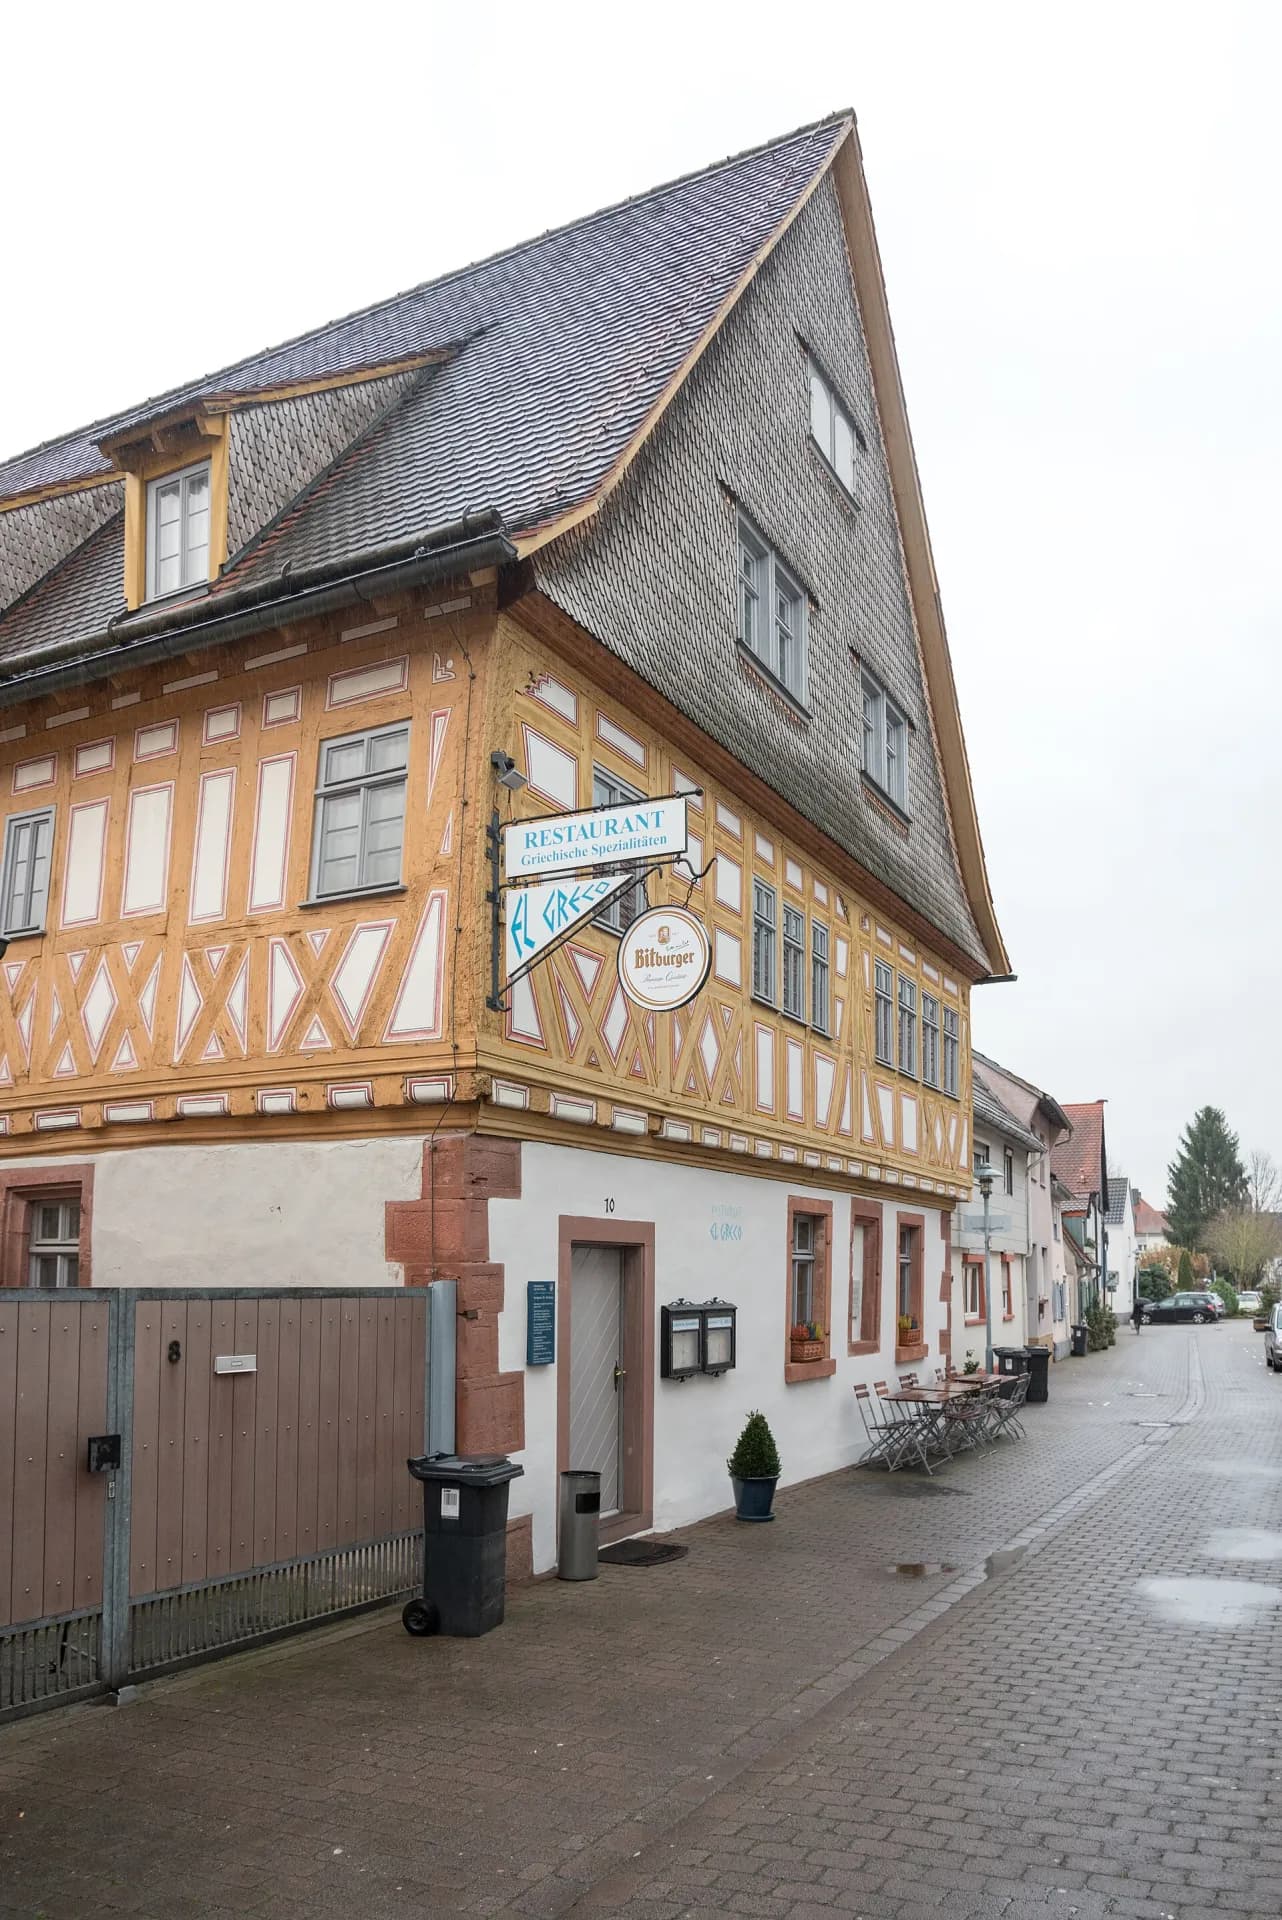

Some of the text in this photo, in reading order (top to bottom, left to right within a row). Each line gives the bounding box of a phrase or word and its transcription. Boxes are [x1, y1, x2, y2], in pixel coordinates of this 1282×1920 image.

[524, 811, 665, 849] RESTAURANT
[521, 835, 667, 867] Griechische Spezialitäten
[510, 881, 610, 960] EL GRECO
[634, 947, 695, 969] Bitburger
[604, 1198, 615, 1213] 10
[168, 1340, 181, 1363] 8
